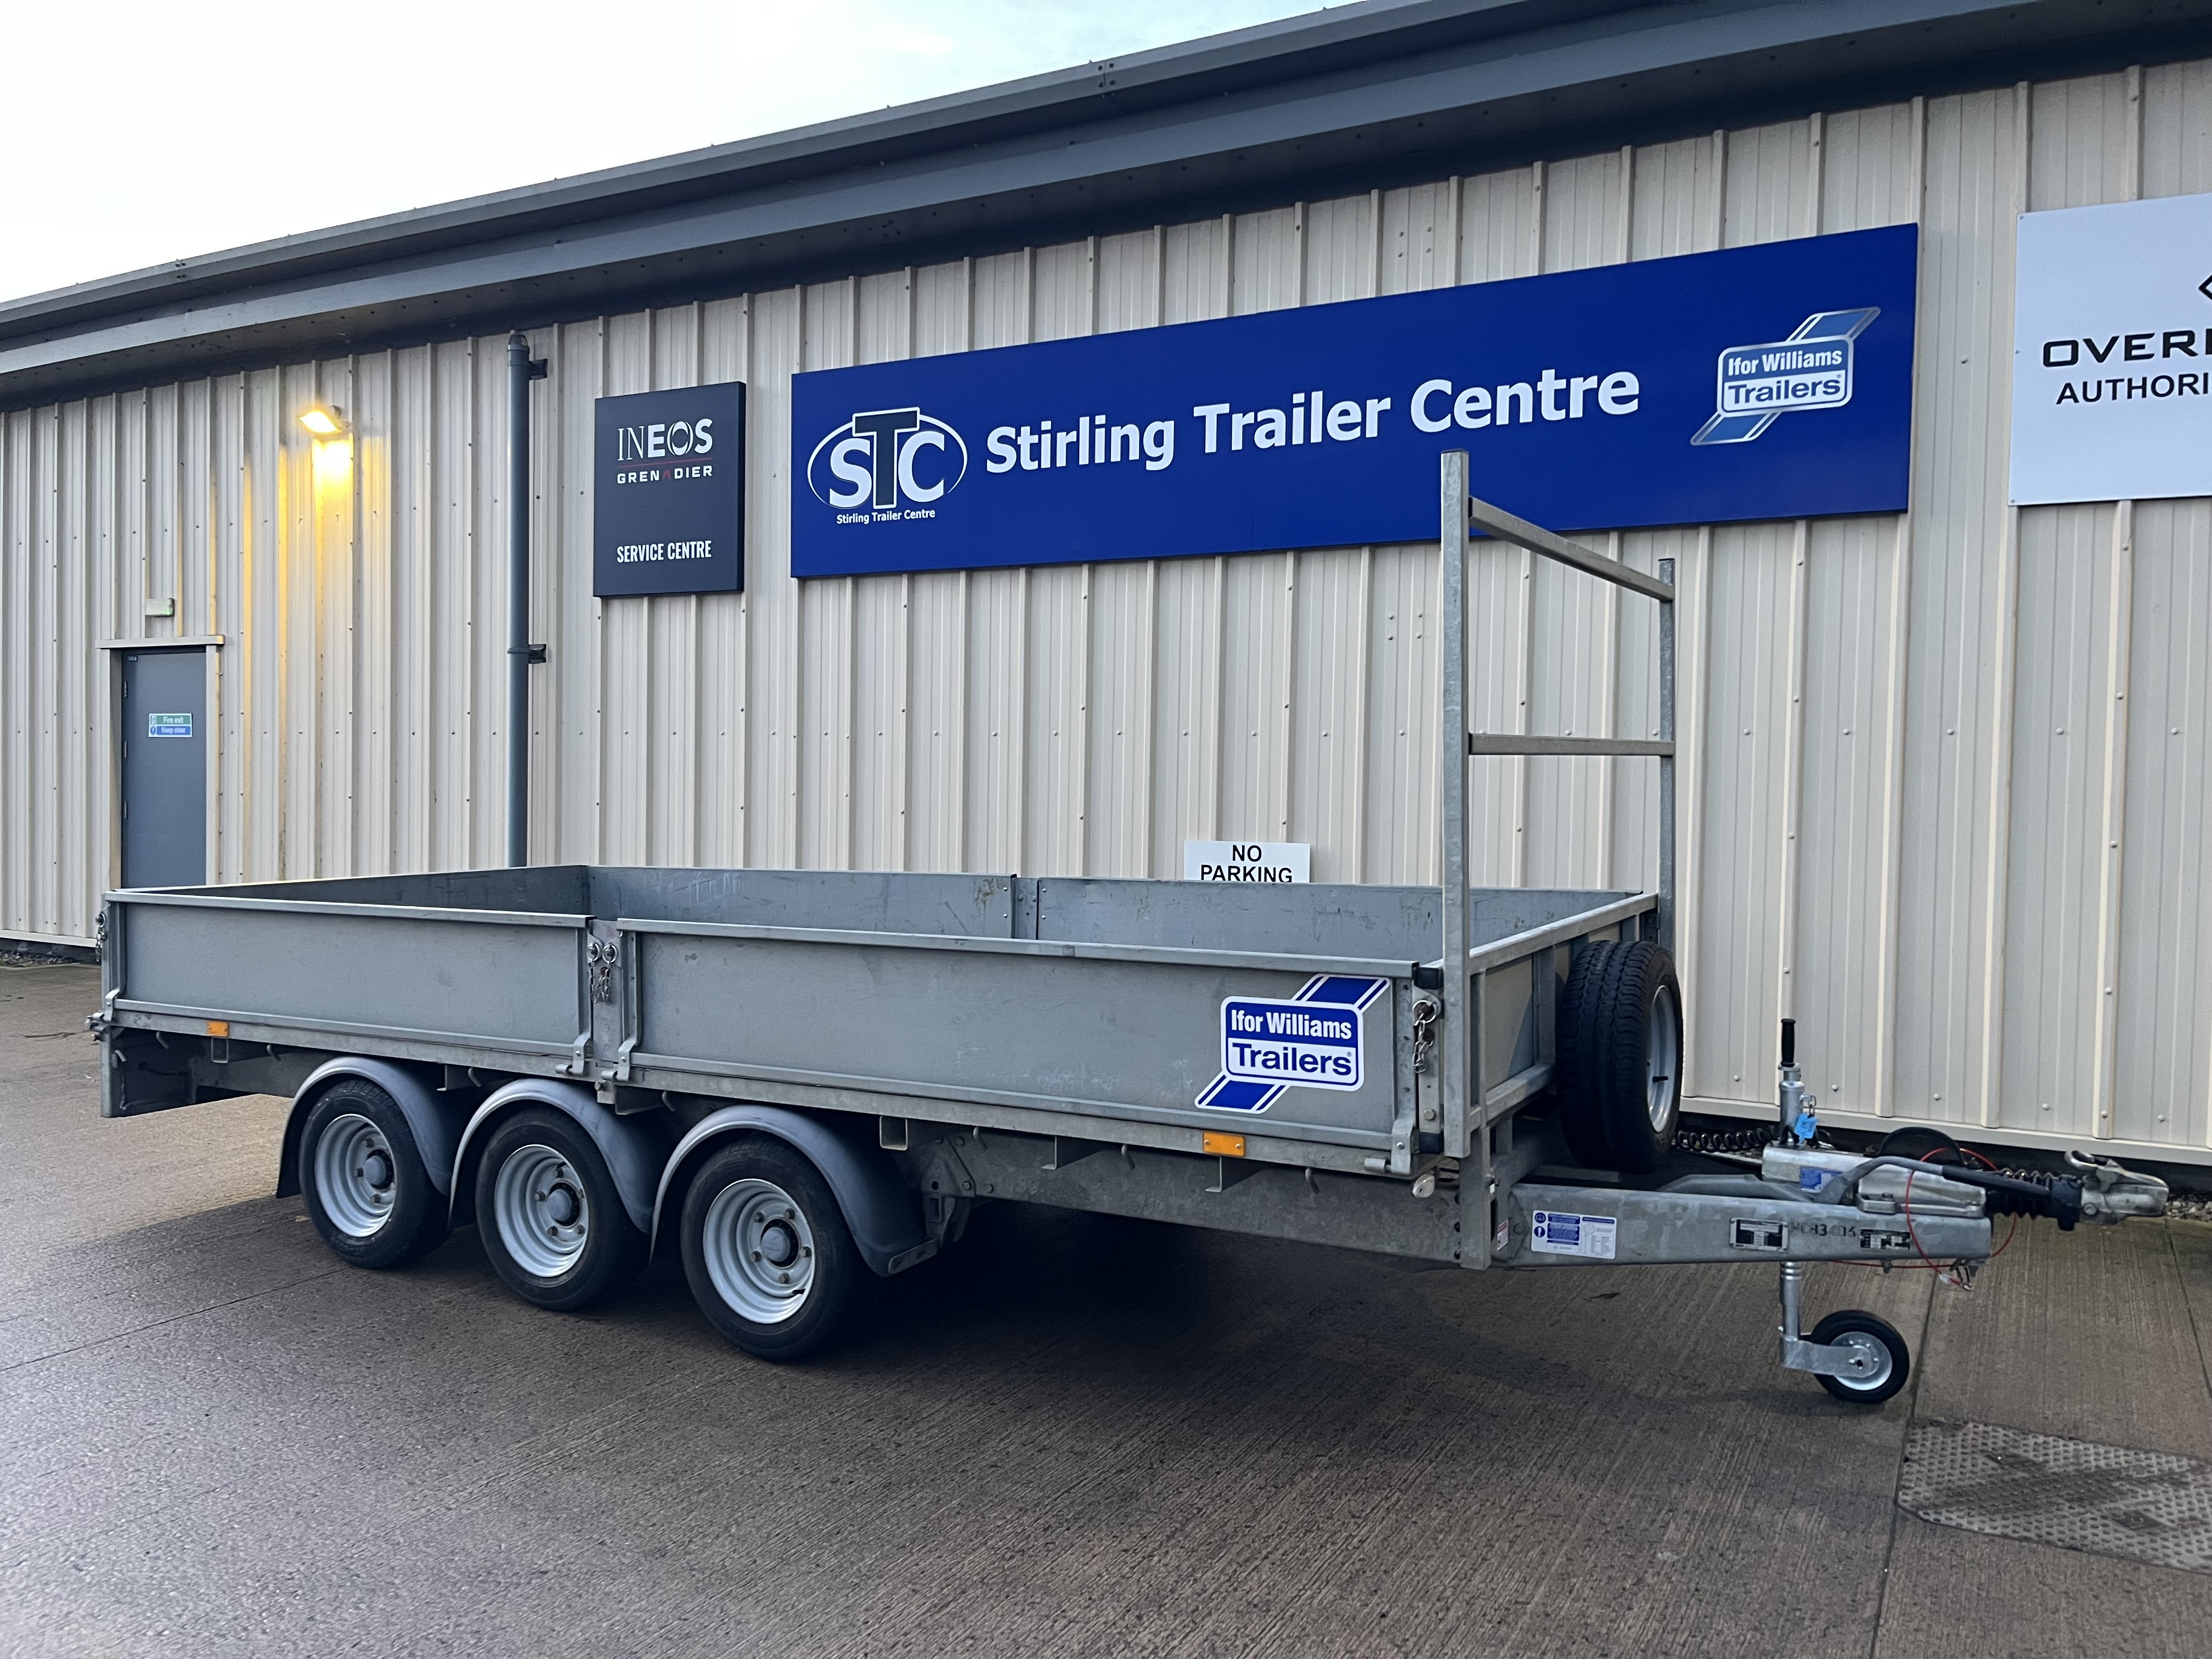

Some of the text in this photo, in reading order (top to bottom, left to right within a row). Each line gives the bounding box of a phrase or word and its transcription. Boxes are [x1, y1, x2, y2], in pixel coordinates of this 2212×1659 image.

[1728, 350, 1842, 376] Ifor Williams
[1728, 379, 1841, 404] Trailers
[2056, 373, 2212, 405] AUTHORI
[987, 369, 1639, 473] Stirling Trailer Centre
[617, 419, 713, 461] INEOS
[830, 407, 945, 509] STC
[617, 465, 713, 484] GRENADIER
[837, 509, 935, 524] Stirling Trailer Centre
[617, 540, 712, 563] SERVICE CENTRE
[1232, 844, 1262, 862] NO
[1201, 864, 1292, 883] PARKING
[1232, 1009, 1352, 1040] Ifor Williams
[1232, 1042, 1352, 1076] Trailers
